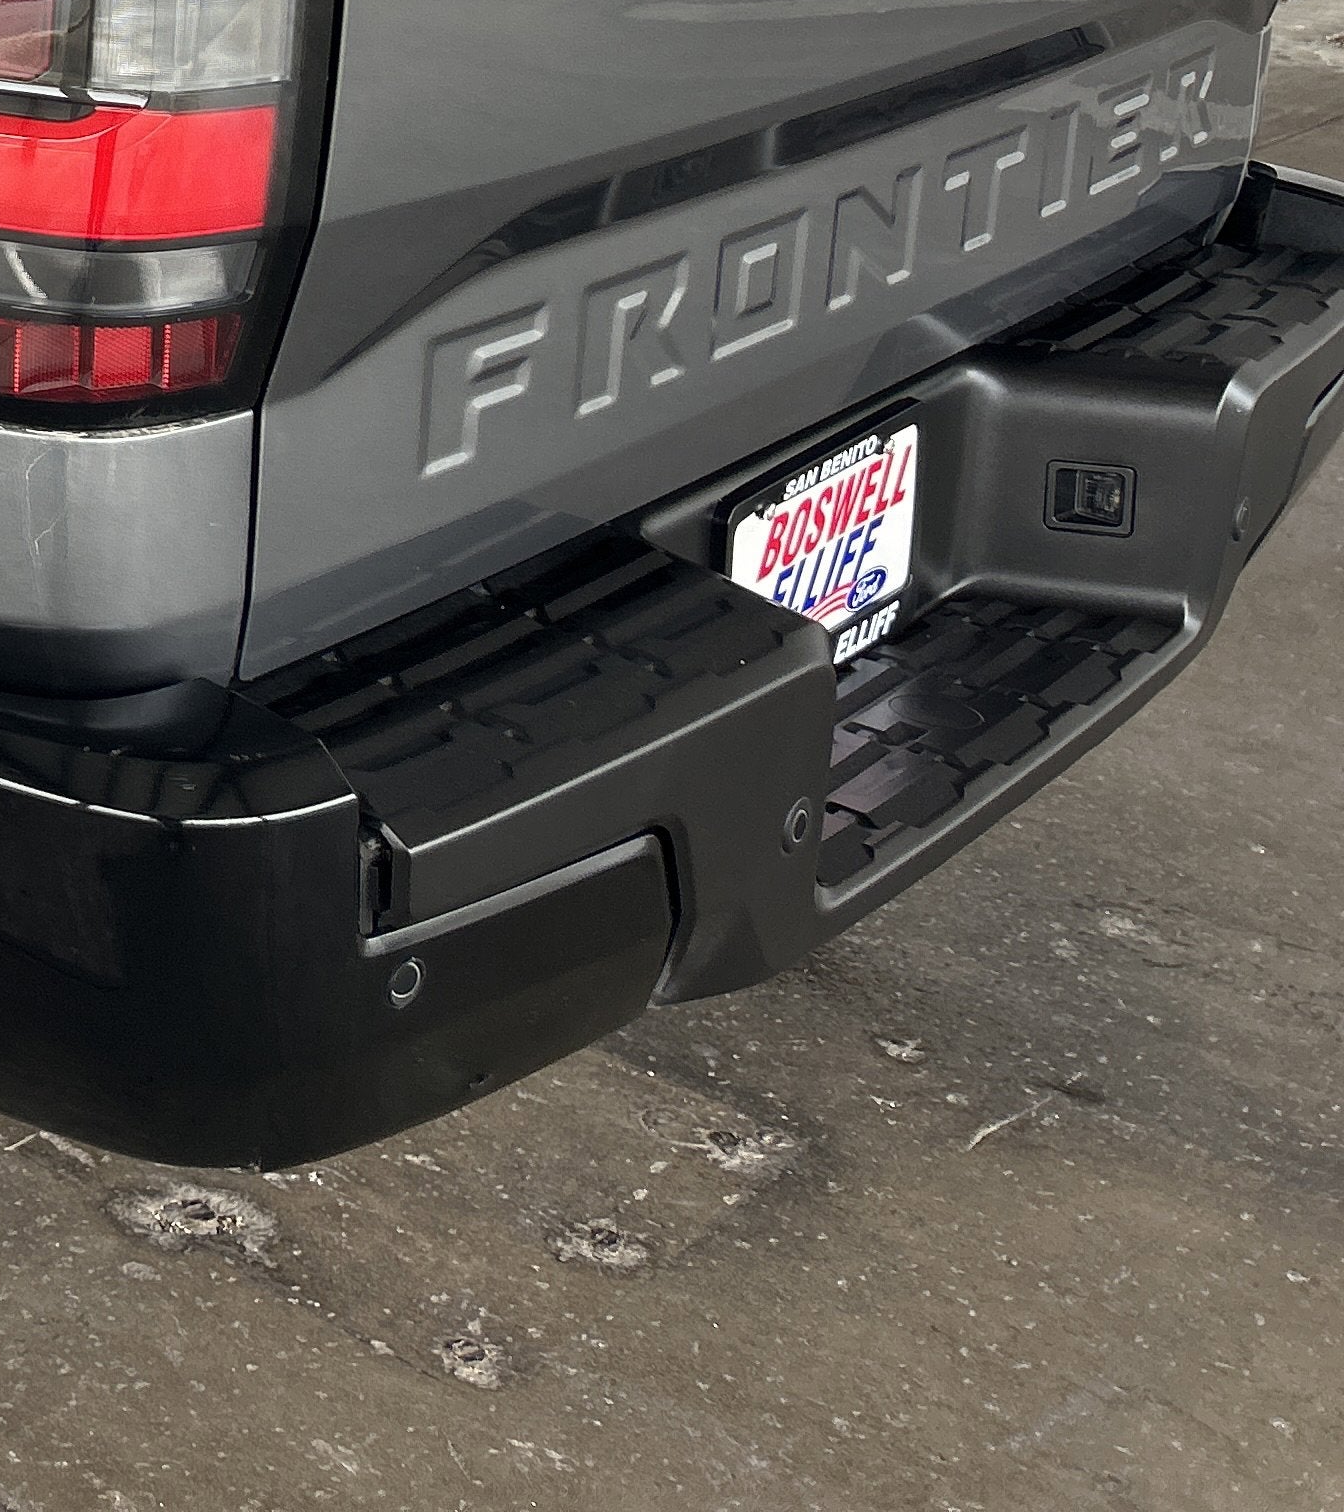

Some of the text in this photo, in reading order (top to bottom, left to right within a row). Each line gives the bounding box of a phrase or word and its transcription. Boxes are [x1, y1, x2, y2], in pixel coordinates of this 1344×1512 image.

[421, 48, 1216, 478] FRONTIER
[756, 445, 912, 583] BOSWELL
[783, 435, 880, 500] SAN BENITO
[833, 600, 900, 665] ELLIFF
